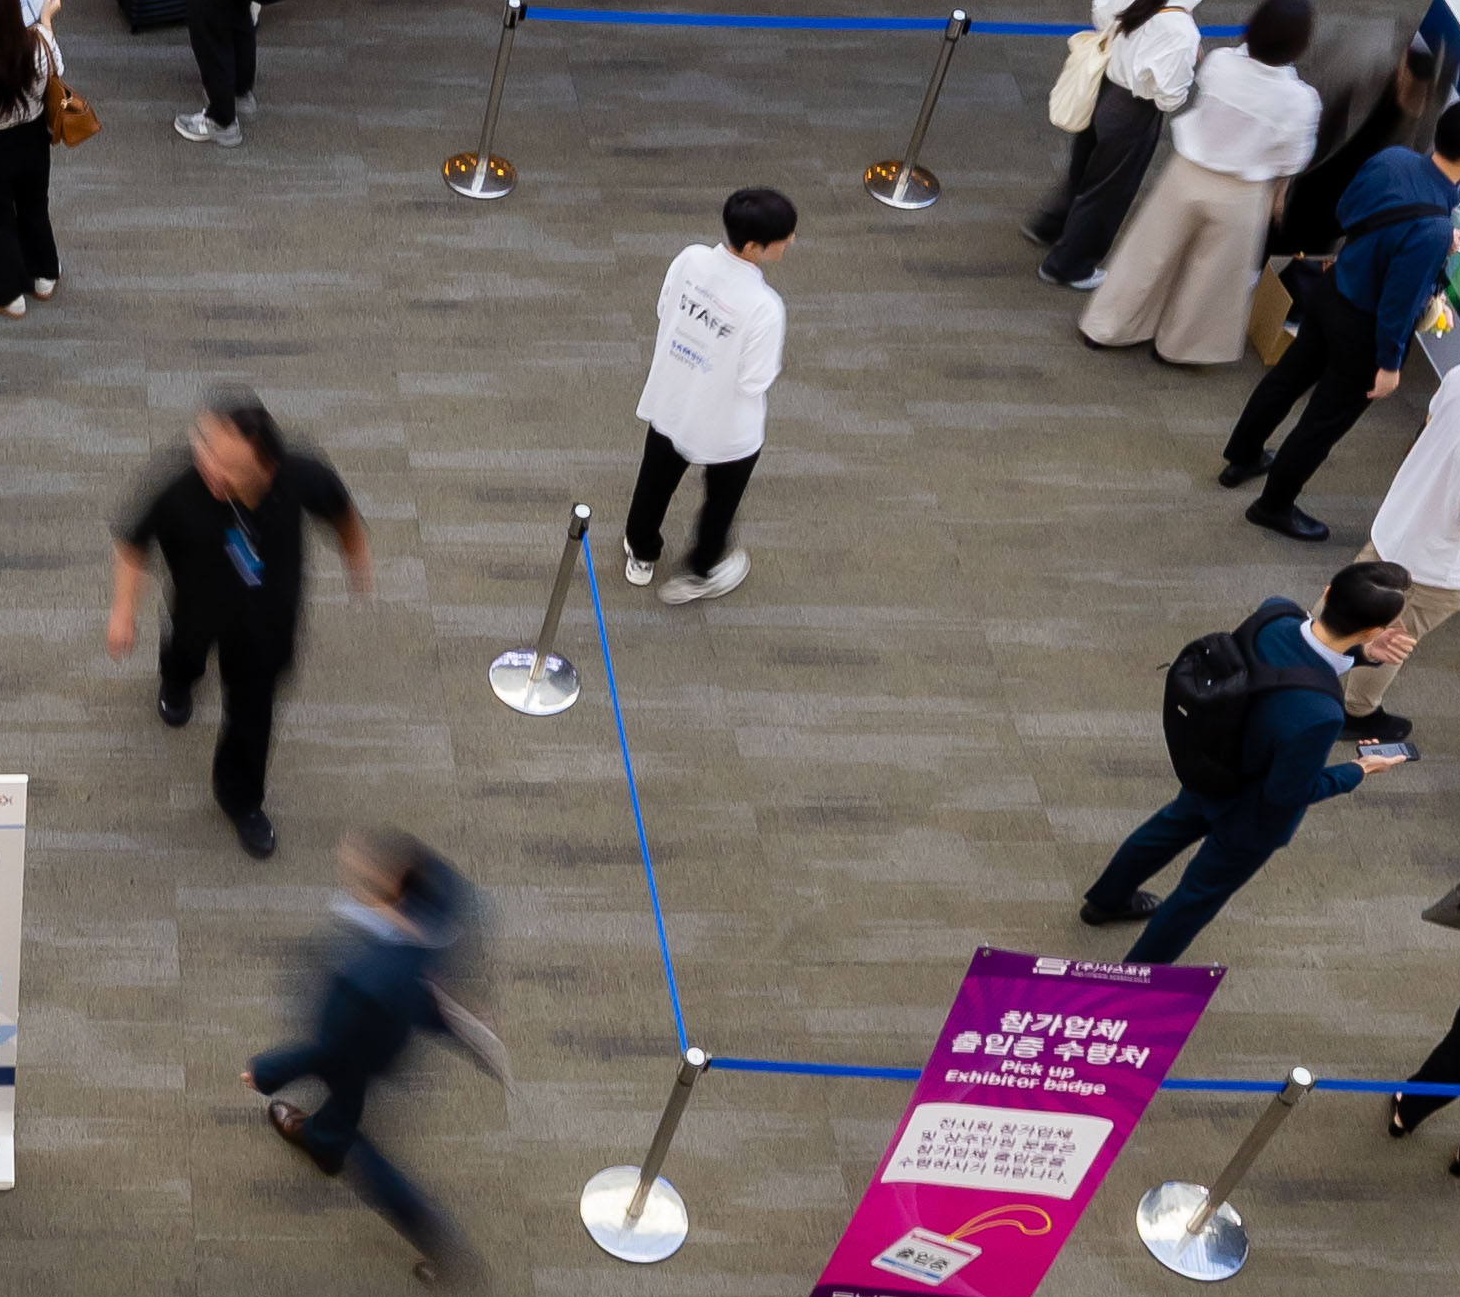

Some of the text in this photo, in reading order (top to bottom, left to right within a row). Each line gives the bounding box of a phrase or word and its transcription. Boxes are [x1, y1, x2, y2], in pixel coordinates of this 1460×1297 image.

[1000, 1010, 1128, 1041] 참가업체
[952, 1031, 1150, 1069] 출입증 수령처
[945, 1069, 1106, 1096] Exhibitor badge
[1001, 1059, 1075, 1080] Pick up
